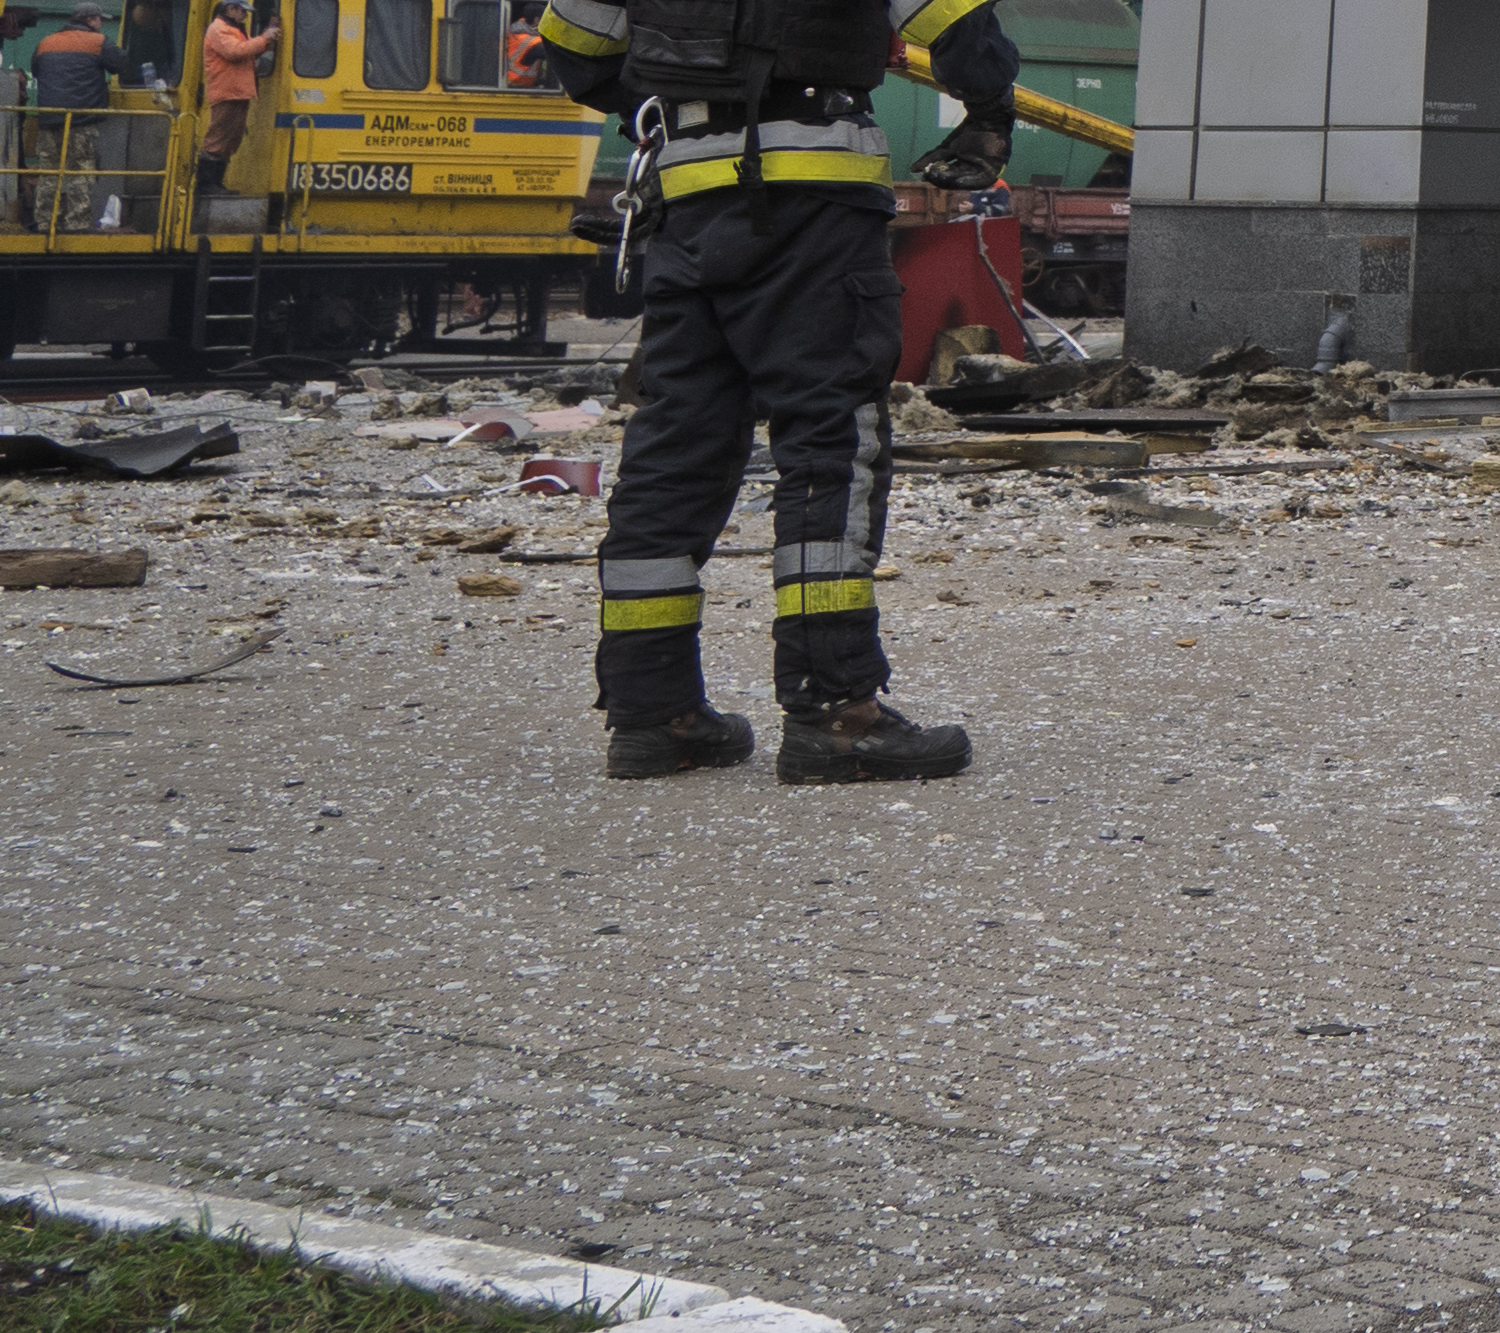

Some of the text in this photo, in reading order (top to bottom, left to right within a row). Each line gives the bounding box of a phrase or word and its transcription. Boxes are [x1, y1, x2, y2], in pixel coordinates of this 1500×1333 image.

[1014, 119, 1041, 133] oup
[365, 135, 471, 148] ЕНЕРГОРЕМТРАНС
[292, 163, 410, 191] 18350686
[447, 173, 493, 186] ВІННИЦЯ
